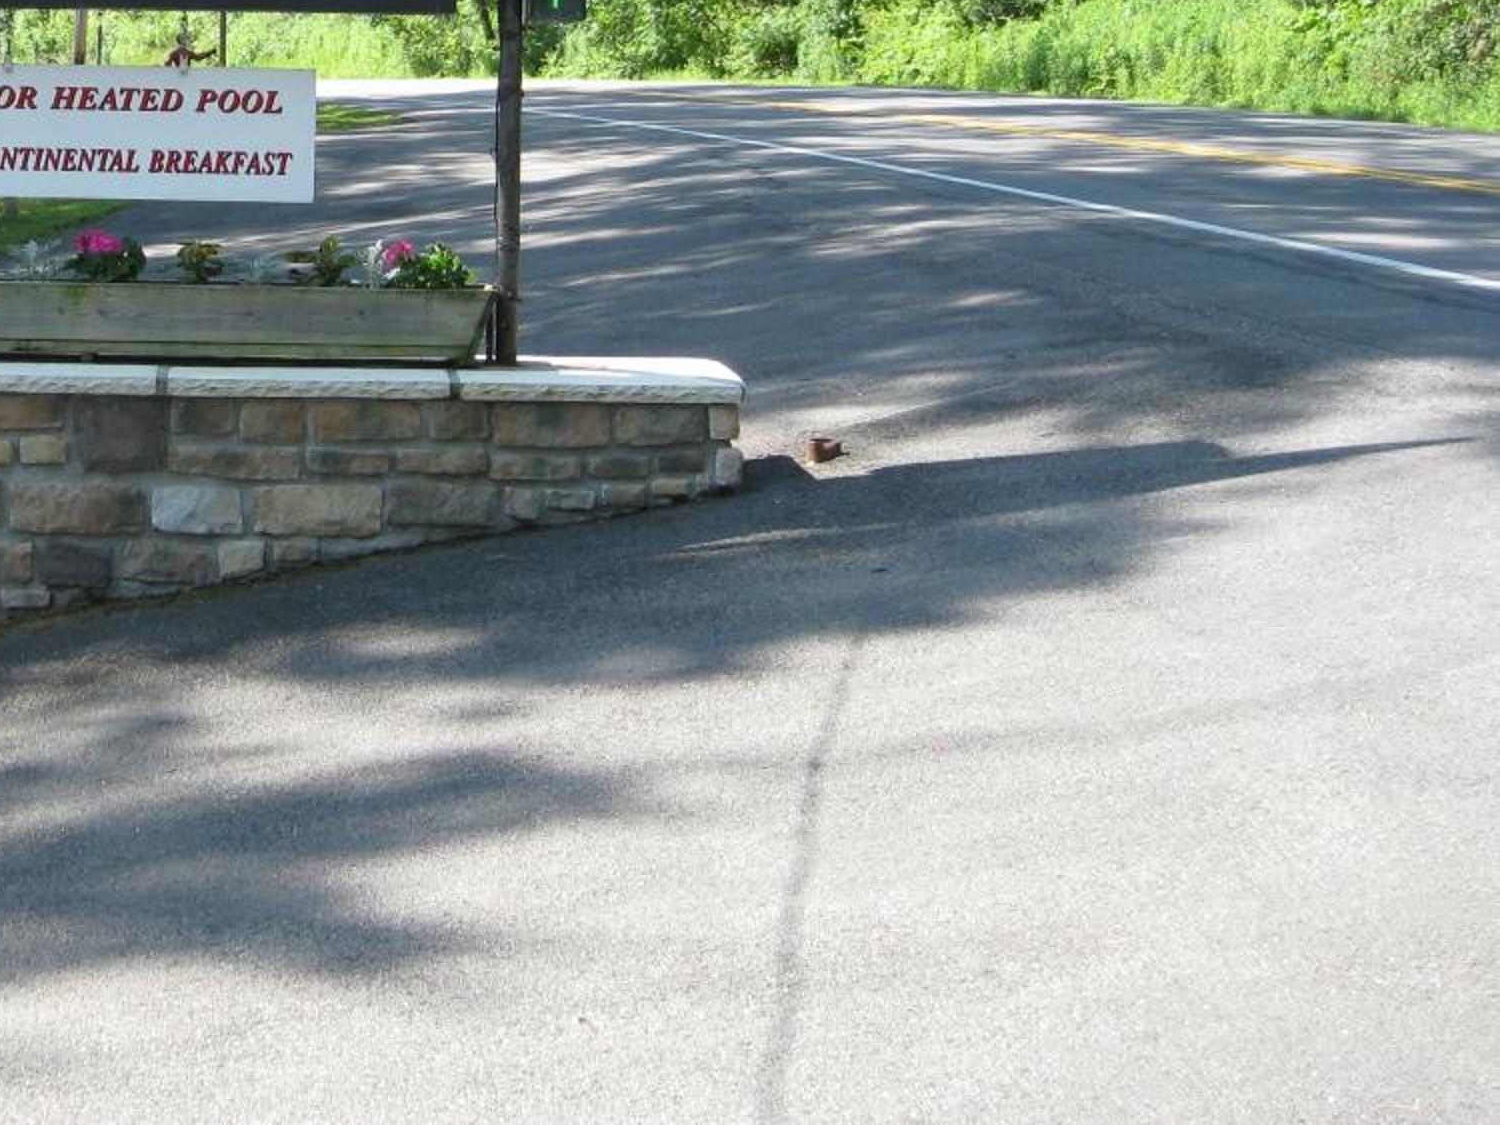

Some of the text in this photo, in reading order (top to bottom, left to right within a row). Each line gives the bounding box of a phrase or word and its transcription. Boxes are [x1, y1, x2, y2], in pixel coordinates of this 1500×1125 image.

[51, 86, 185, 113] HEATED
[195, 89, 284, 115] POOL
[148, 149, 294, 177] BREAKFAST
